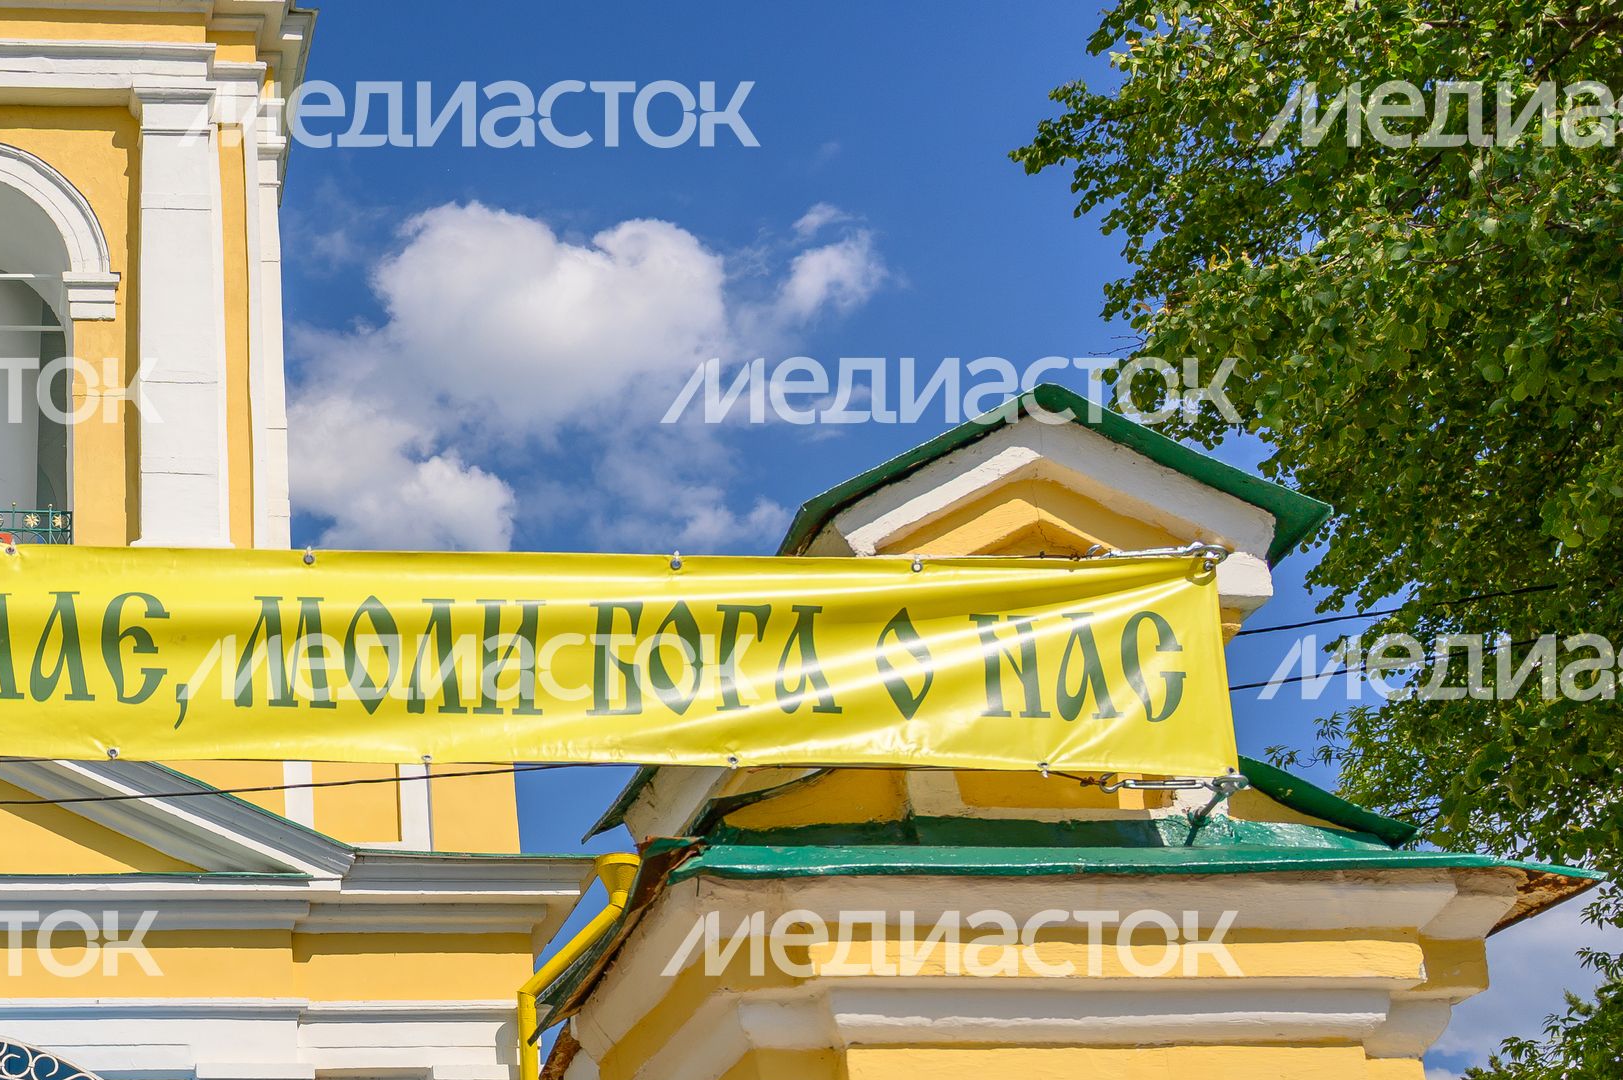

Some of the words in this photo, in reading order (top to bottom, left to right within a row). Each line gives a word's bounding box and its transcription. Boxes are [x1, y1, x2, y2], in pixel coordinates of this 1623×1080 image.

[234, 596, 547, 716] МОЛИ
[585, 599, 843, 719] БОГА
[876, 606, 935, 720] О
[968, 610, 1186, 724] НАС
